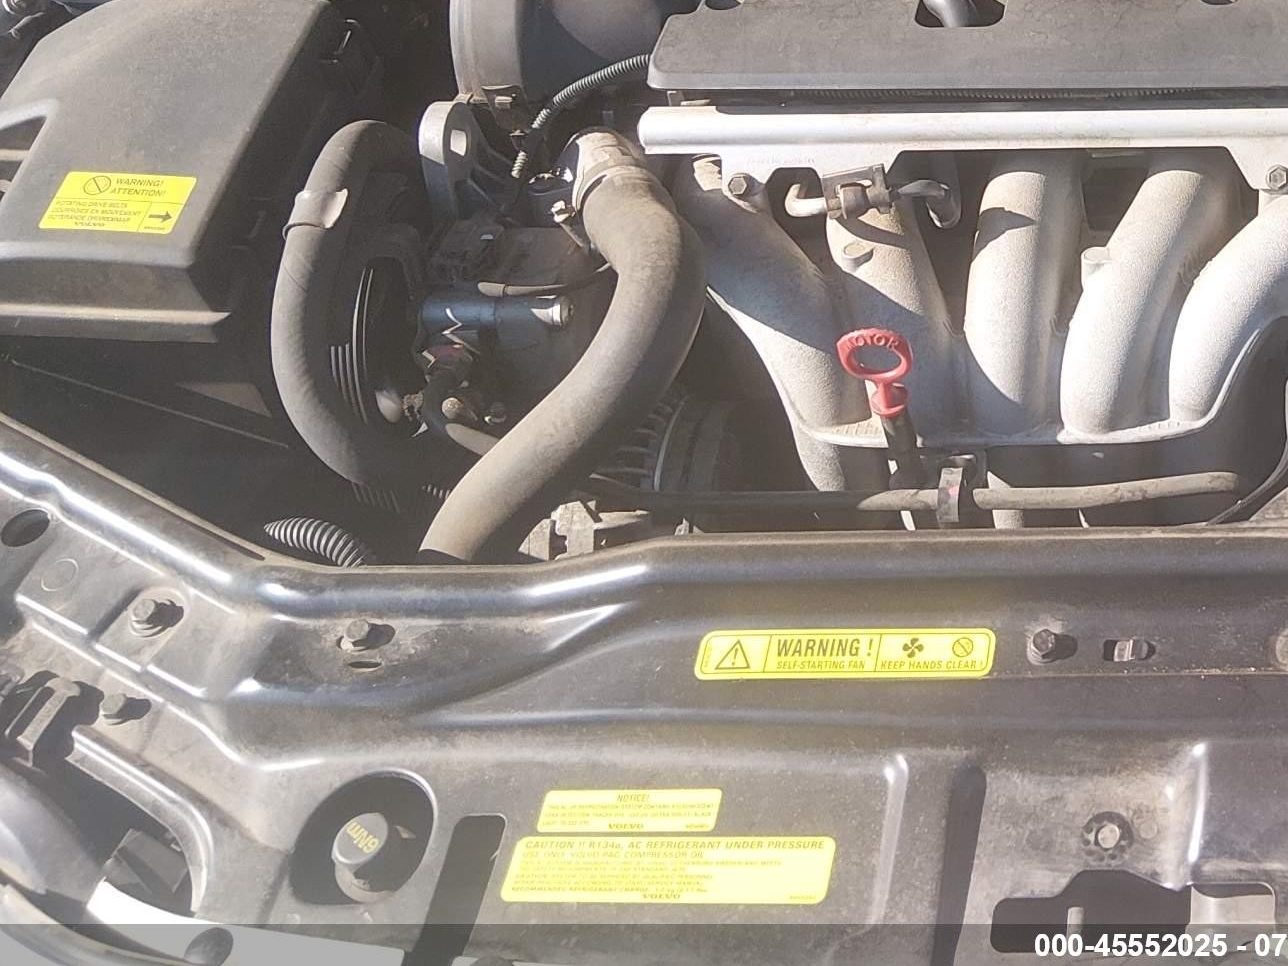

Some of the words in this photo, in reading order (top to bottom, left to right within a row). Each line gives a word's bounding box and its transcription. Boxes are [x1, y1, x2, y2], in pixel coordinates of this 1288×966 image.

[116, 177, 164, 187] WARNING!
[110, 188, 166, 197] ATTENTION!
[777, 638, 860, 657] WARNING
[776, 661, 845, 670] SELF-STARTING
[847, 660, 865, 669] FAN
[881, 660, 906, 670] KEEP
[908, 660, 943, 670] HANDS
[946, 660, 977, 669] CLEAR
[617, 794, 650, 803] NOTICE!
[346, 821, 379, 854] 6Nm
[525, 841, 574, 849] CAUTION
[627, 841, 642, 849] AC
[645, 841, 721, 849] REFRIGERANT
[725, 841, 764, 849] UNDER
[767, 841, 824, 849] PRESSURE
